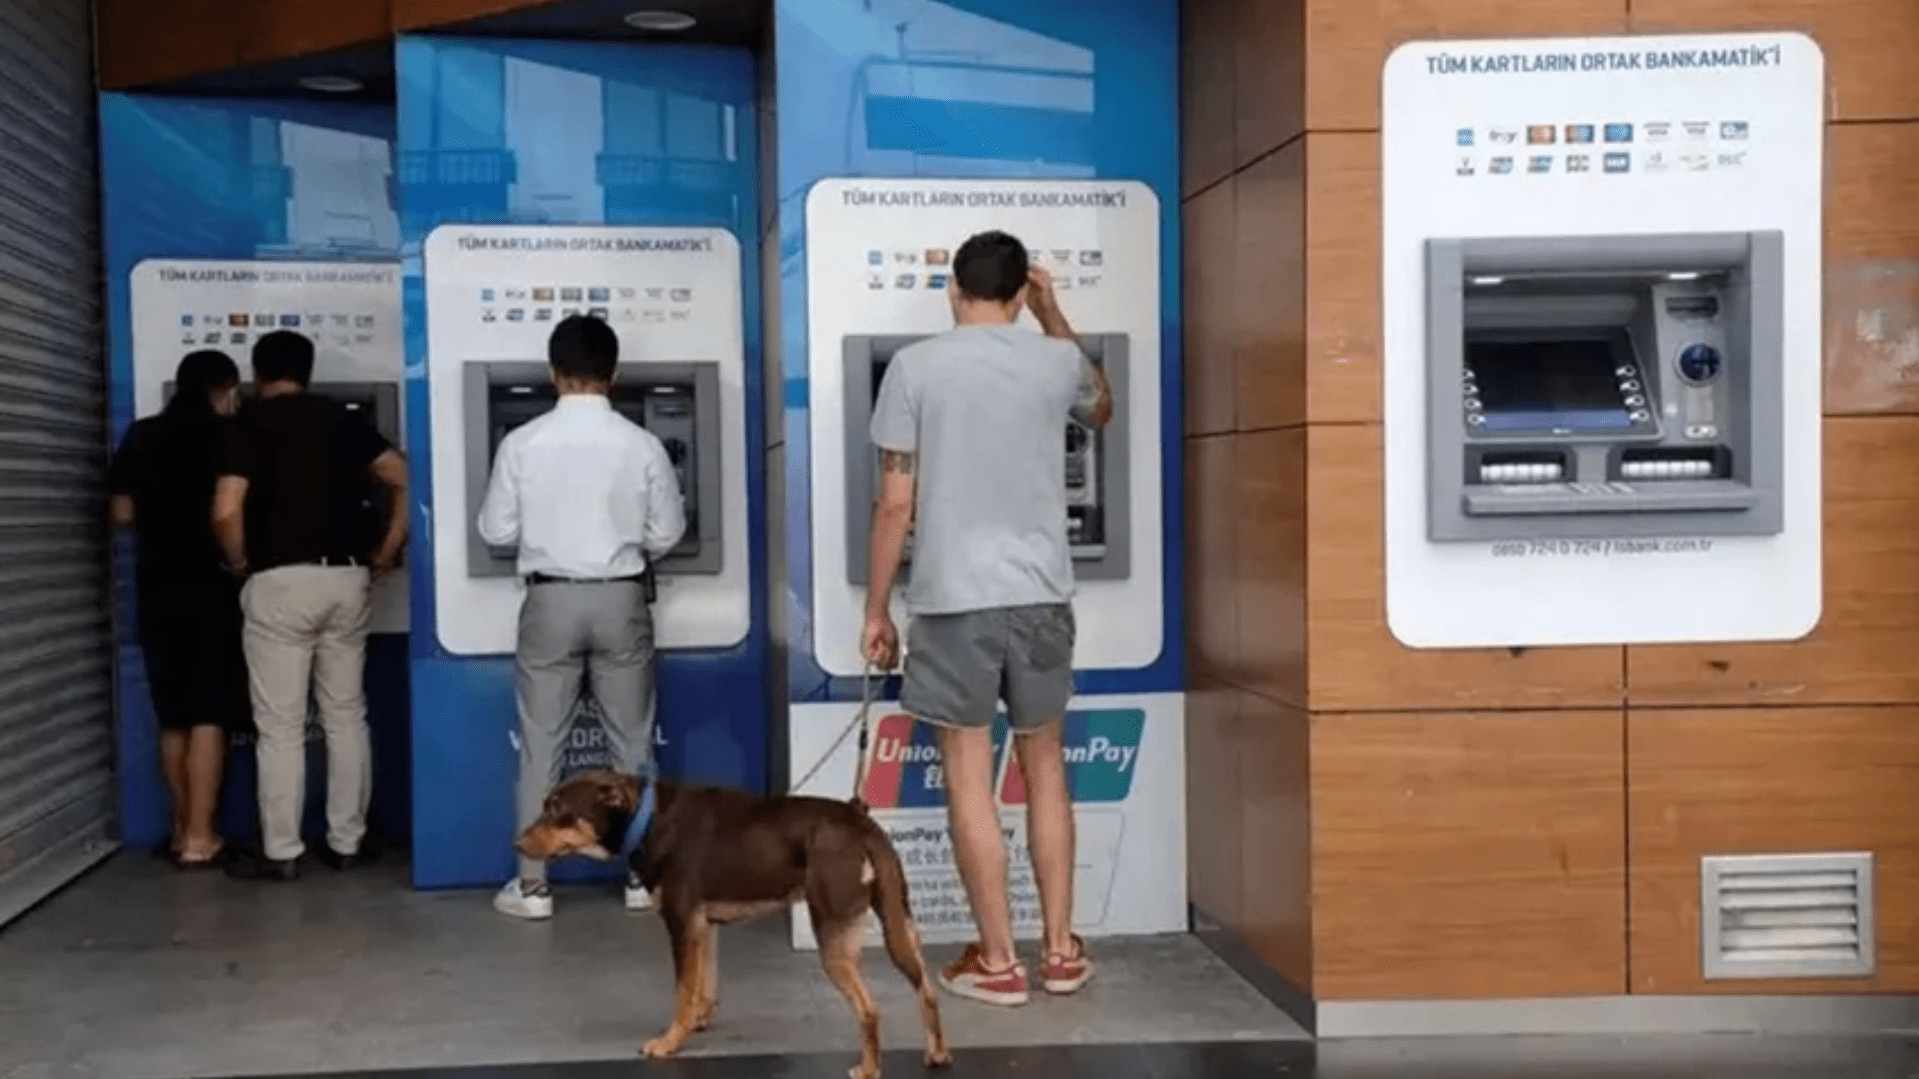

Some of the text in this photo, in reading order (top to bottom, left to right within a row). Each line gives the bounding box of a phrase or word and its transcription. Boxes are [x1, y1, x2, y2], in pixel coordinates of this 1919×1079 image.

[1427, 53, 1467, 75] TÜM
[1470, 52, 1577, 73] KARTLARIN
[1581, 51, 1641, 71] ORTAK
[842, 188, 878, 207] TÜM
[879, 191, 965, 208] KARTLARIN
[968, 191, 1016, 208] ORTAK
[458, 234, 488, 250] TÜM
